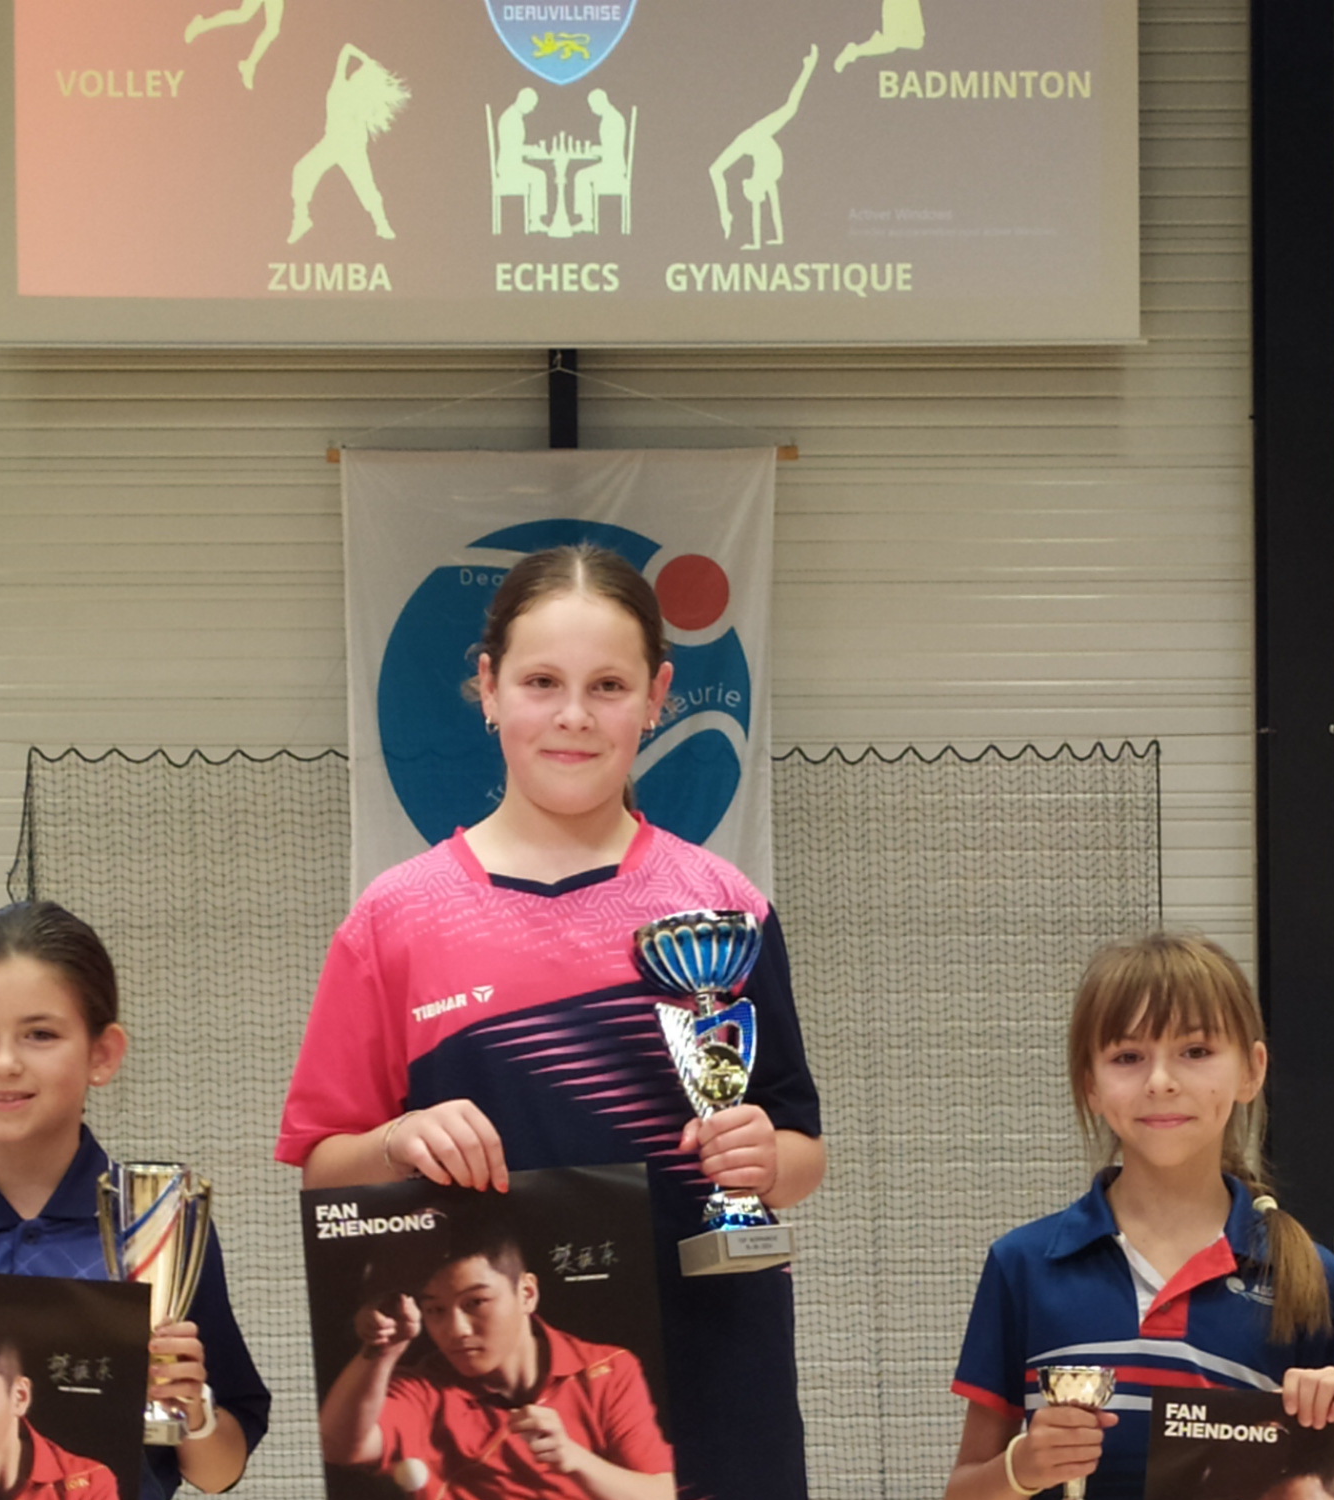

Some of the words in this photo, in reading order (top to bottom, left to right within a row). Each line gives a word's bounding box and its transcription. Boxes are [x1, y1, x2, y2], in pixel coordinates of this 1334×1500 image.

[55, 69, 184, 98] VOLLEY
[878, 70, 1091, 99] BADMINTON
[267, 262, 392, 292] ZUMBA
[495, 262, 619, 293] ECHECS
[665, 262, 913, 297] GYMNASTIQUE
[412, 992, 467, 1023] TIBHAR
[316, 1203, 358, 1221] FAN
[317, 1213, 435, 1239] ZHENDONG
[1166, 1404, 1206, 1421] FAN
[1164, 1421, 1278, 1443] ZHENDONG
